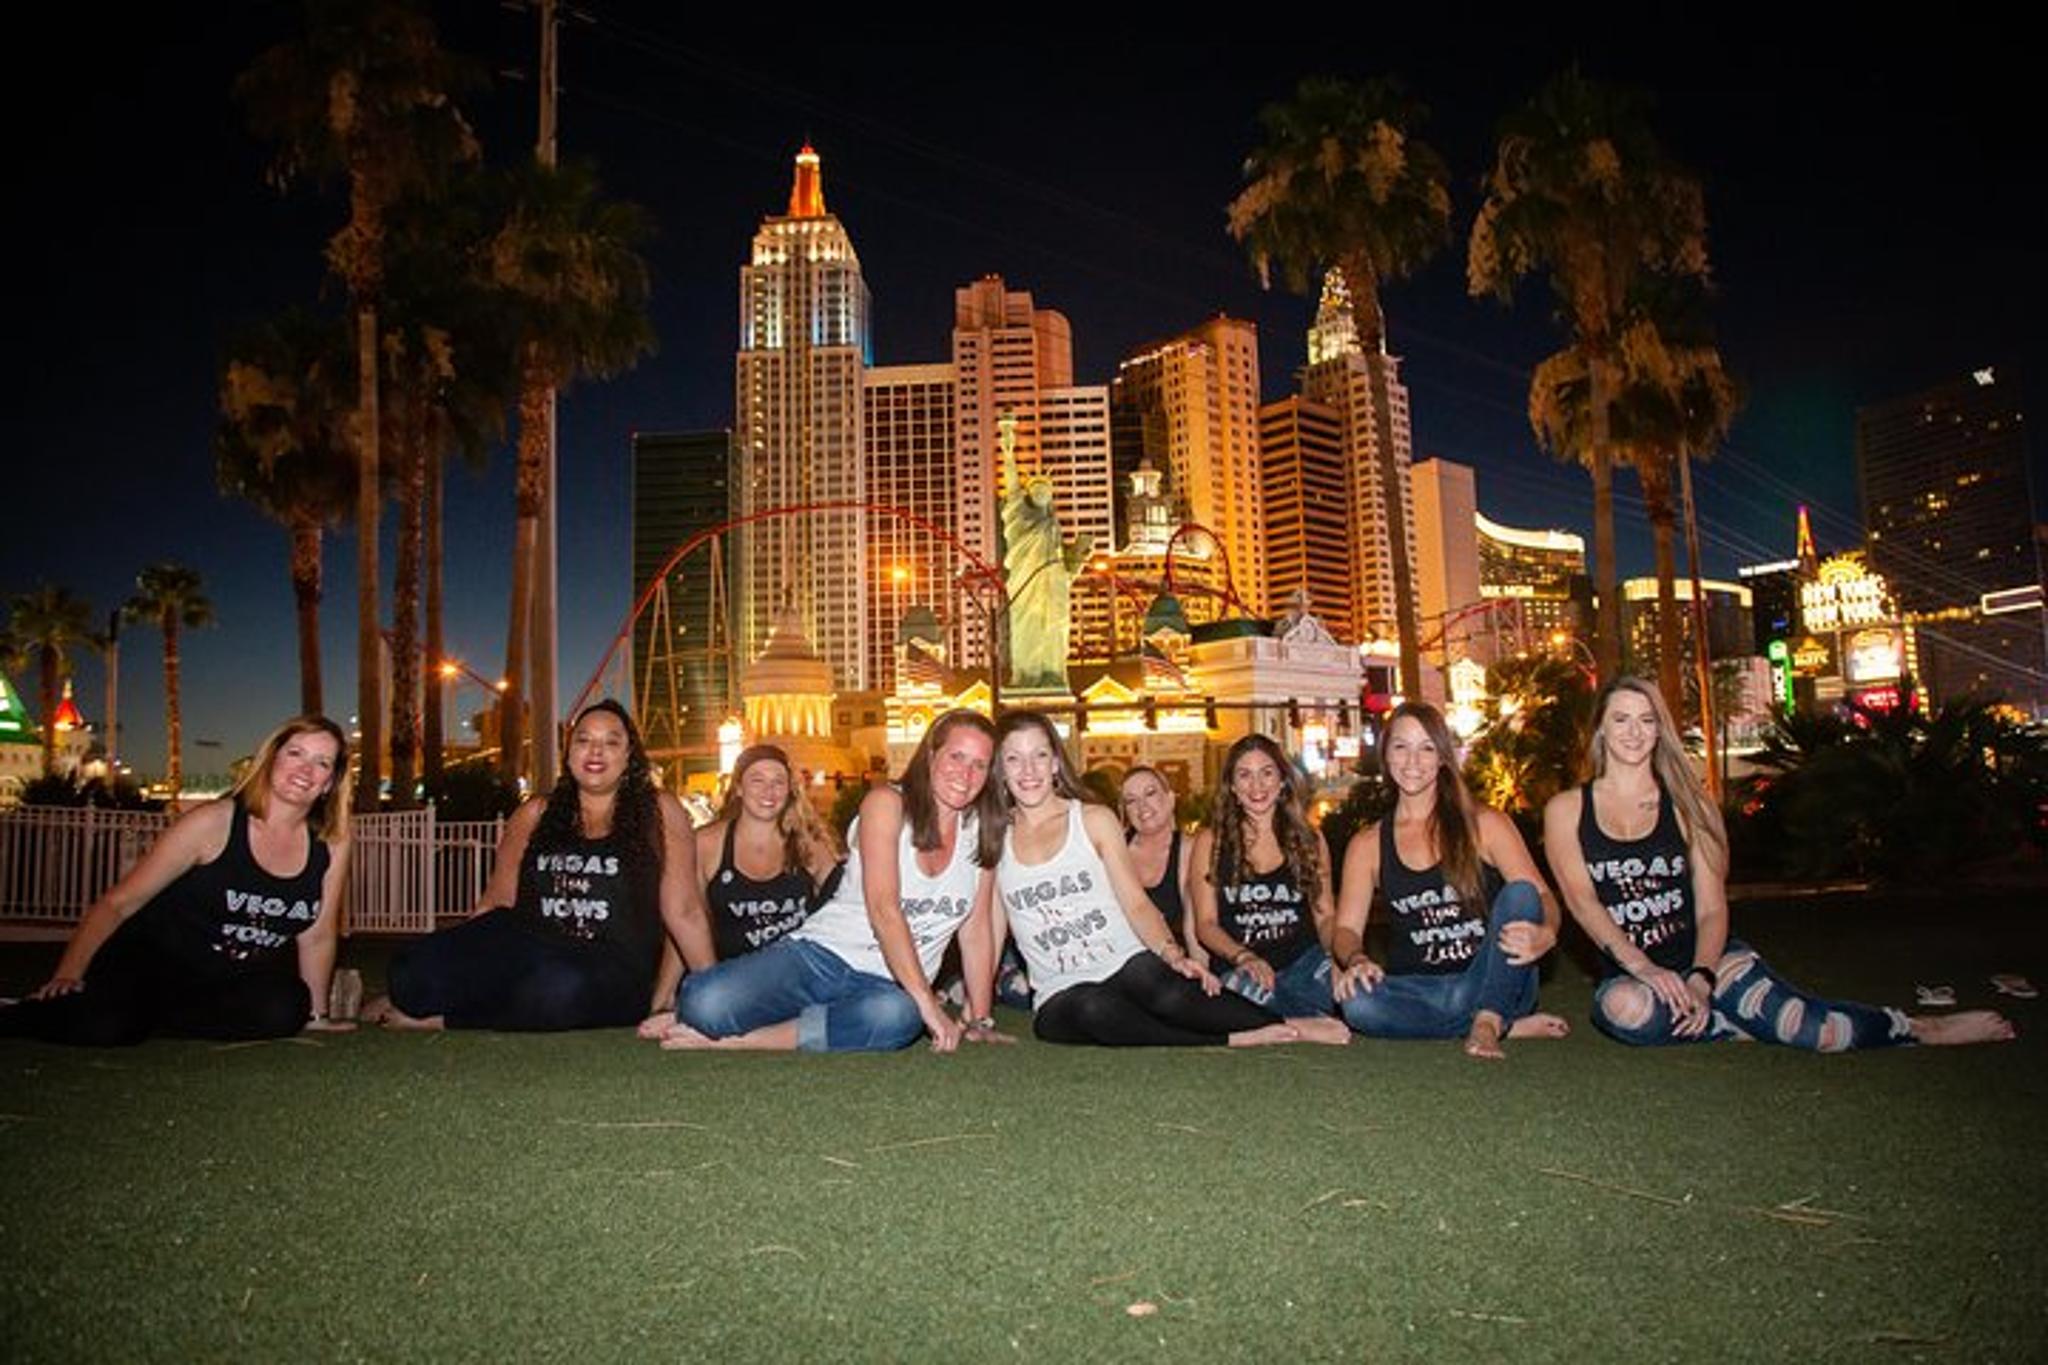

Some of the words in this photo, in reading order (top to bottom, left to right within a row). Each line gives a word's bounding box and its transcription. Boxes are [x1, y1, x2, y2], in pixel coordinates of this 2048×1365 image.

[536, 854, 619, 876] VEGAS
[1587, 855, 1685, 882] VEGAS
[1005, 870, 1093, 911] VEGAS
[1390, 885, 1459, 914] VEGA
[541, 898, 610, 920] VOWS
[1234, 908, 1299, 926] VOWS
[1607, 889, 1684, 925] VOWS
[1033, 908, 1108, 951] VOWS
[1410, 918, 1485, 945] VOWS
